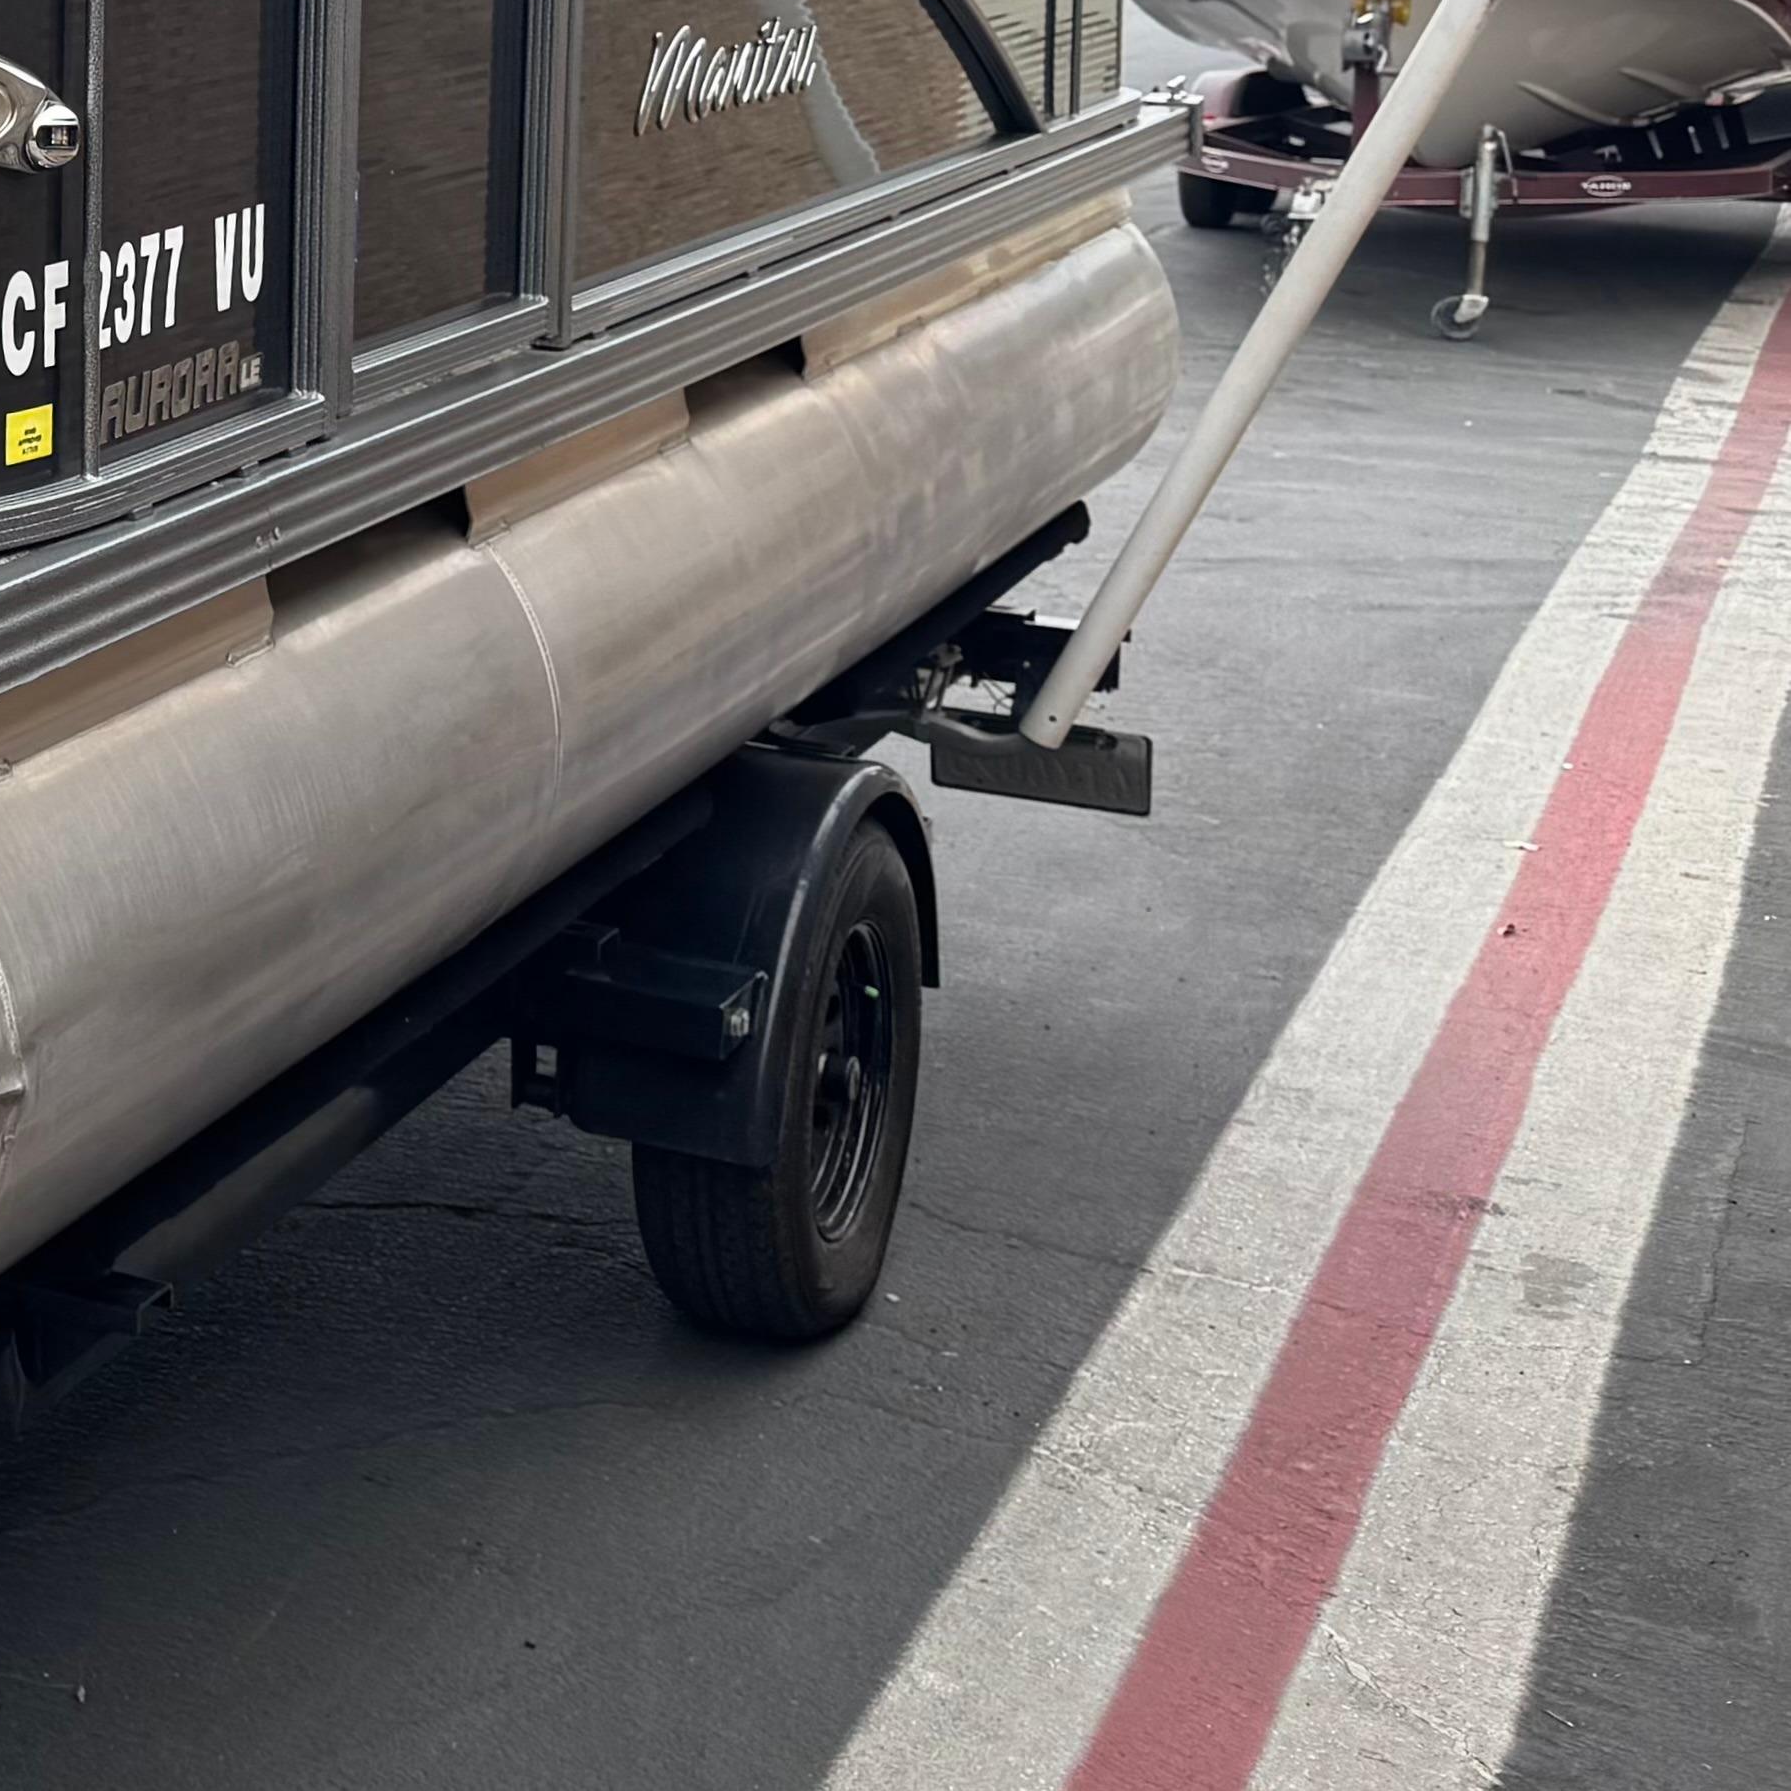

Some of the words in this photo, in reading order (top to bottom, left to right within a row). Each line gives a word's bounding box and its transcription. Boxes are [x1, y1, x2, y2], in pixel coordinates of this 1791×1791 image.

[2, 260, 69, 376] CF
[99, 225, 184, 350] 2377
[214, 203, 265, 312] VU
[100, 340, 239, 445] AURORA
[240, 356, 263, 389] LE
